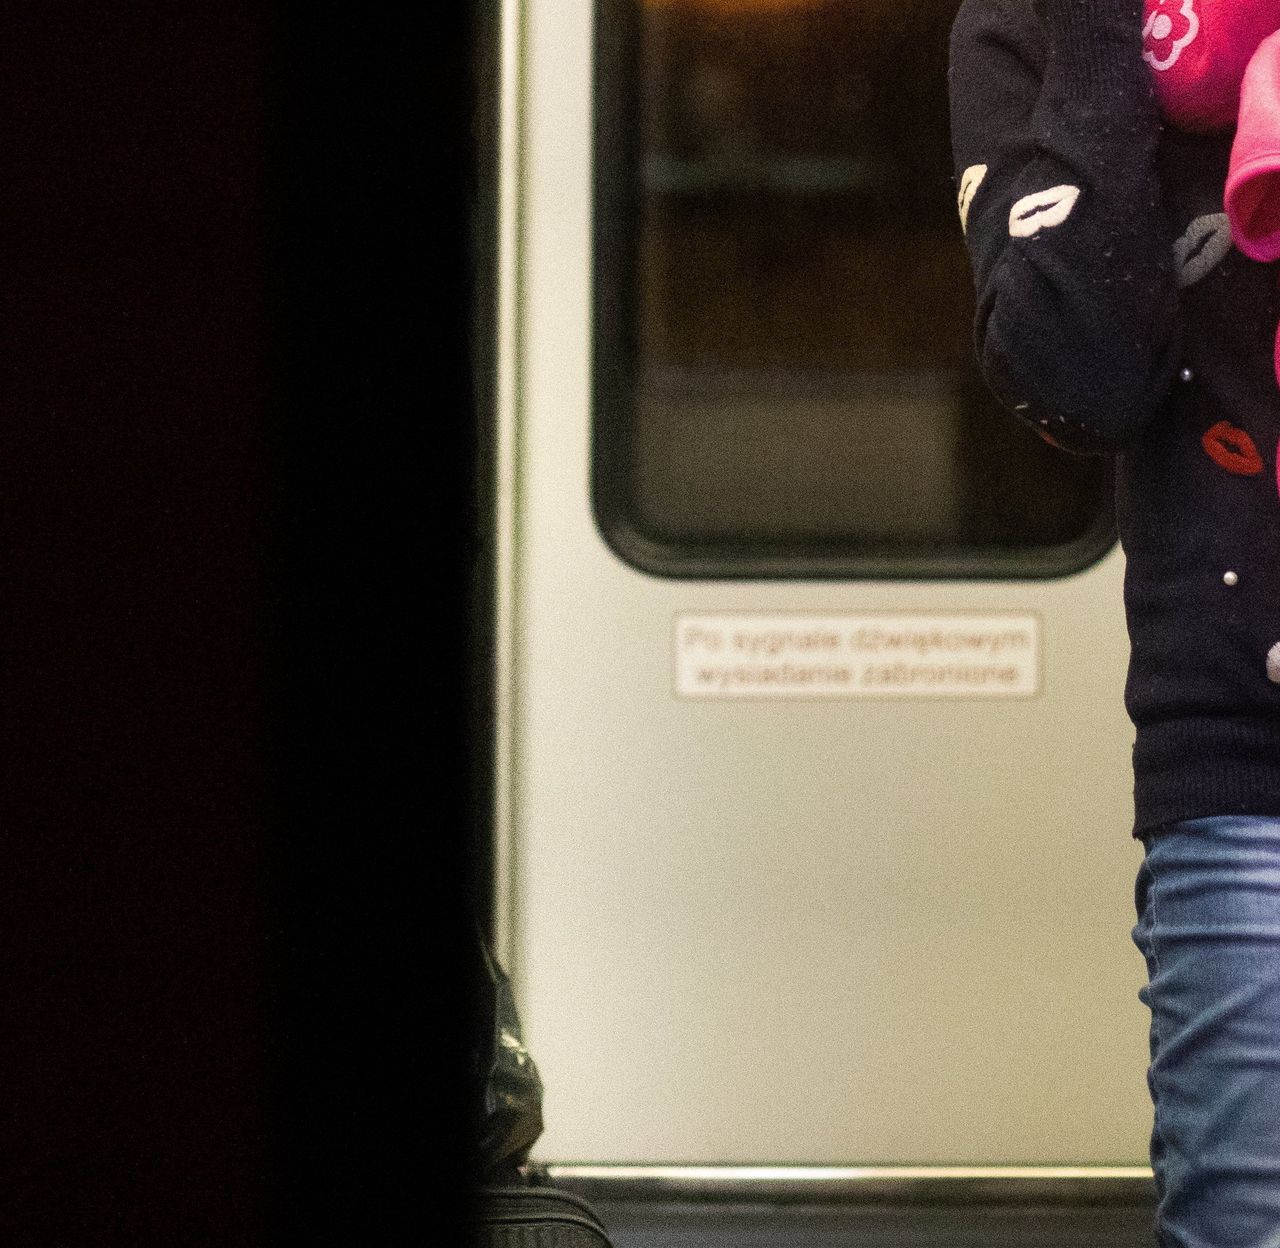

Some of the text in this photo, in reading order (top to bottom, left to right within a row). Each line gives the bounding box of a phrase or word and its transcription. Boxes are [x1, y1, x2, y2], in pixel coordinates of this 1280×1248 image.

[685, 626, 723, 649] Po
[733, 627, 841, 657] sygnale
[697, 662, 1019, 689] wysiadanie zabronione
